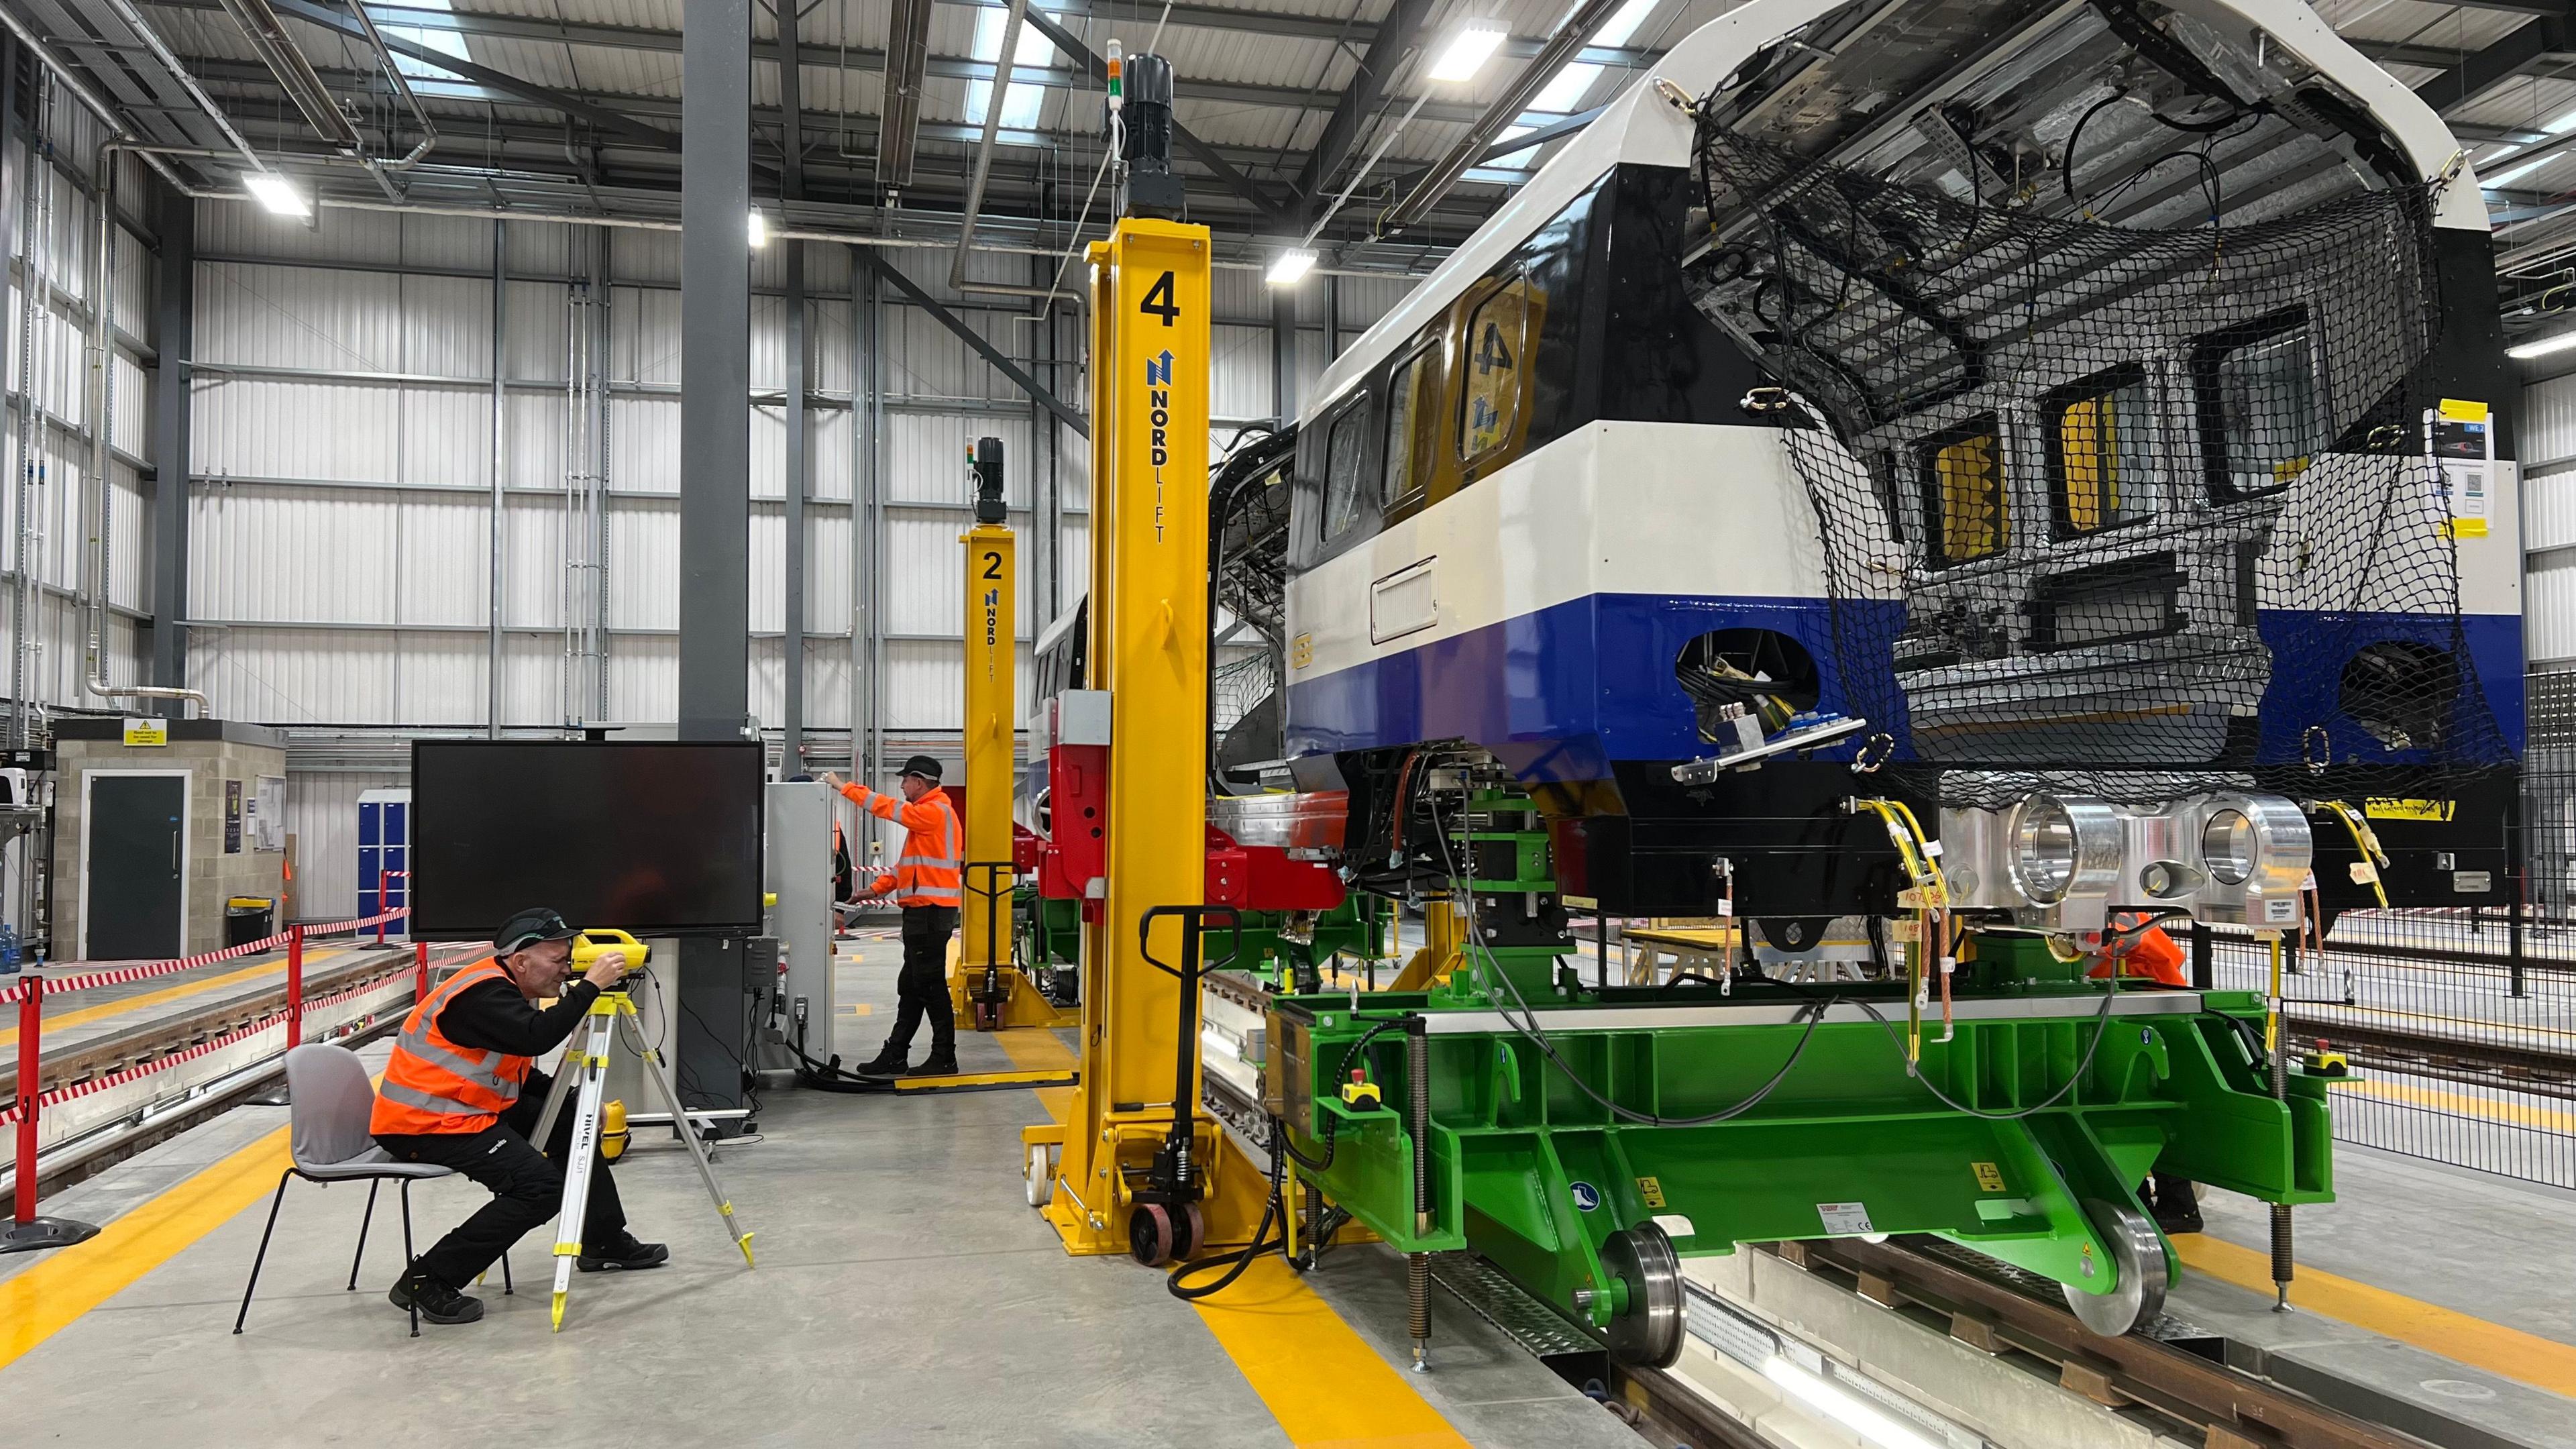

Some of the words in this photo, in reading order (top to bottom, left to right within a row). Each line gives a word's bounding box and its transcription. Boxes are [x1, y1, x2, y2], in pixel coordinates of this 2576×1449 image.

[1140, 270, 1180, 327] 4
[983, 551, 1002, 580] 2
[1904, 924, 1919, 932] 108
[581, 1114, 592, 1149] NIVEL
